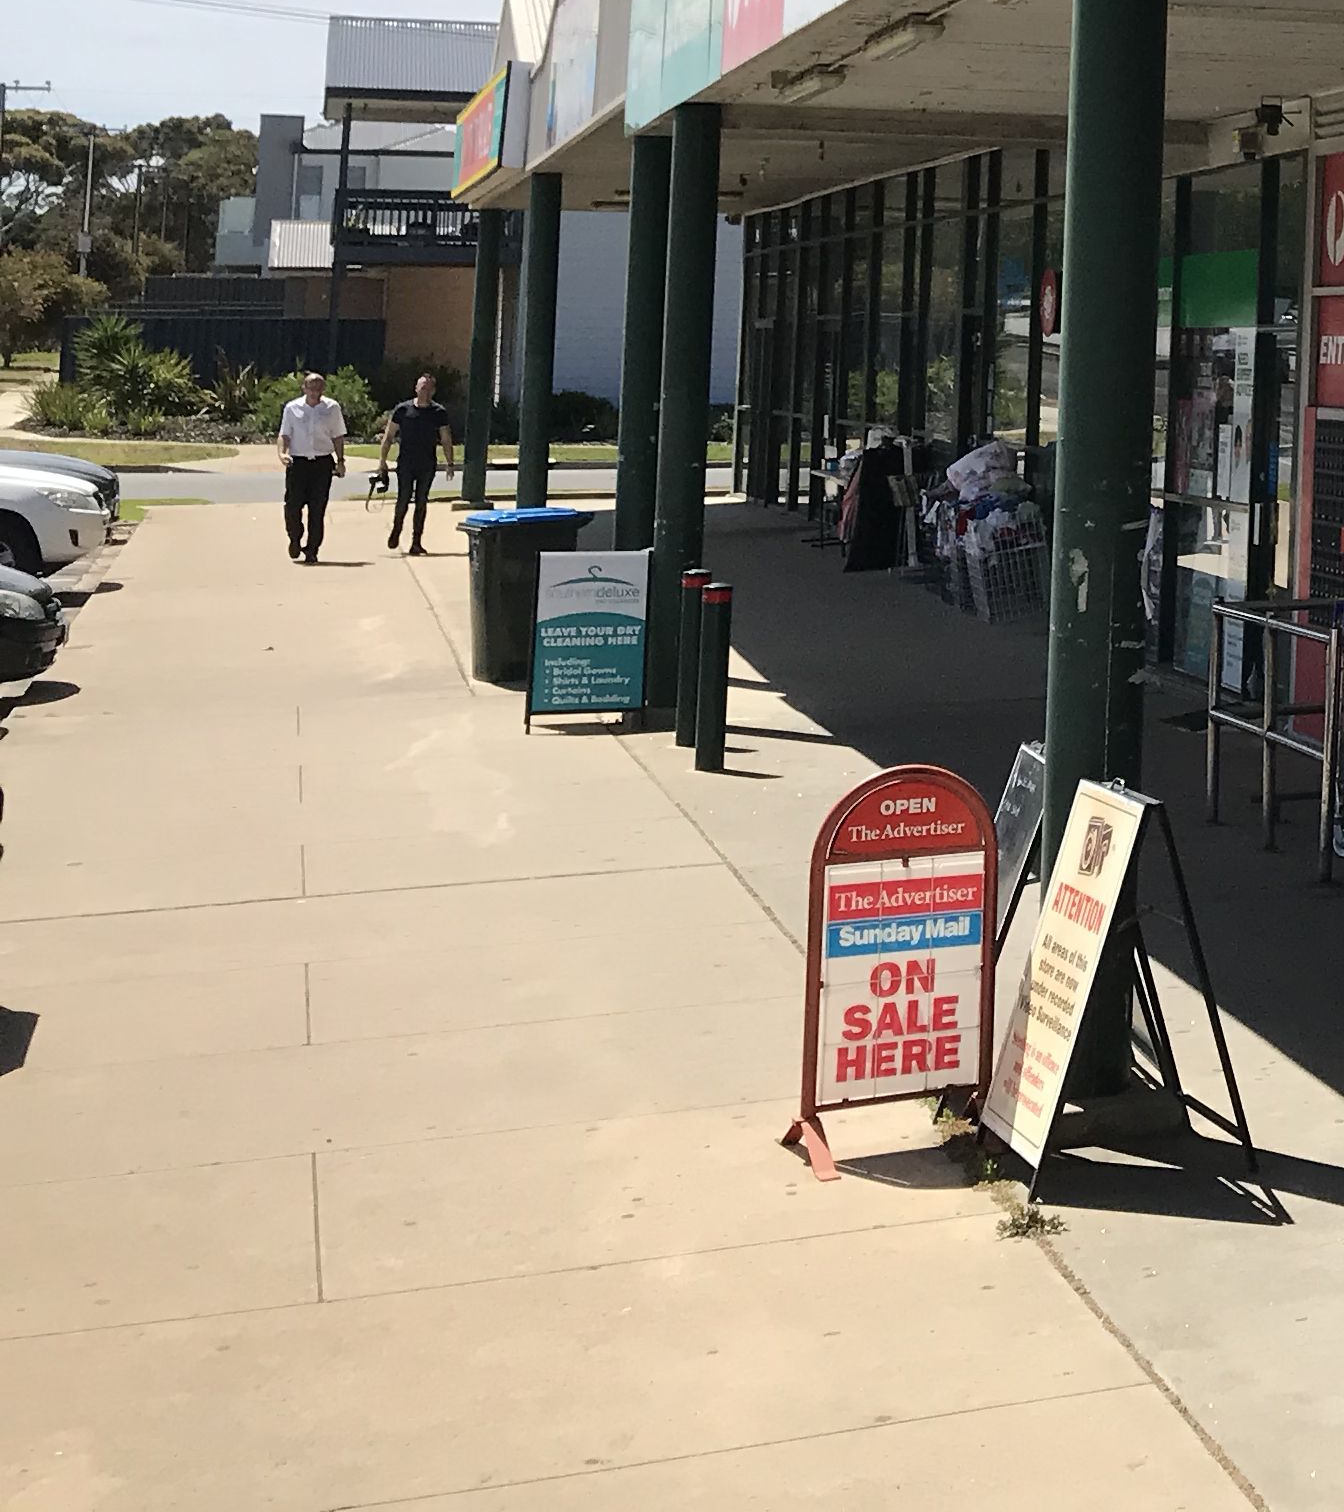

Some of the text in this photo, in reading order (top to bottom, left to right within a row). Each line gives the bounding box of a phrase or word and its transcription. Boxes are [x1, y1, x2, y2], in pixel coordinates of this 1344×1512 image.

[596, 586, 640, 599] deluxe
[540, 625, 641, 637] LEAVE YOUR DRY
[543, 636, 638, 647] CLEANING HERE
[552, 677, 579, 685] Shirts
[591, 675, 630, 685] Laundry
[583, 667, 616, 675] Gowns
[880, 797, 936, 816] OPEN
[848, 820, 965, 842] The Advertiser
[835, 884, 978, 912] The Advertiser
[1052, 881, 1107, 936] ATTENTION
[838, 916, 970, 947] Sunday Mail
[1042, 933, 1088, 973] All areas of this
[869, 958, 936, 998] ON
[1039, 958, 1079, 992] store are now
[1048, 990, 1076, 1017] recorded
[841, 995, 960, 1041] SALE
[1036, 1005, 1072, 1042] Surveillance
[836, 1034, 961, 1083] HERE
